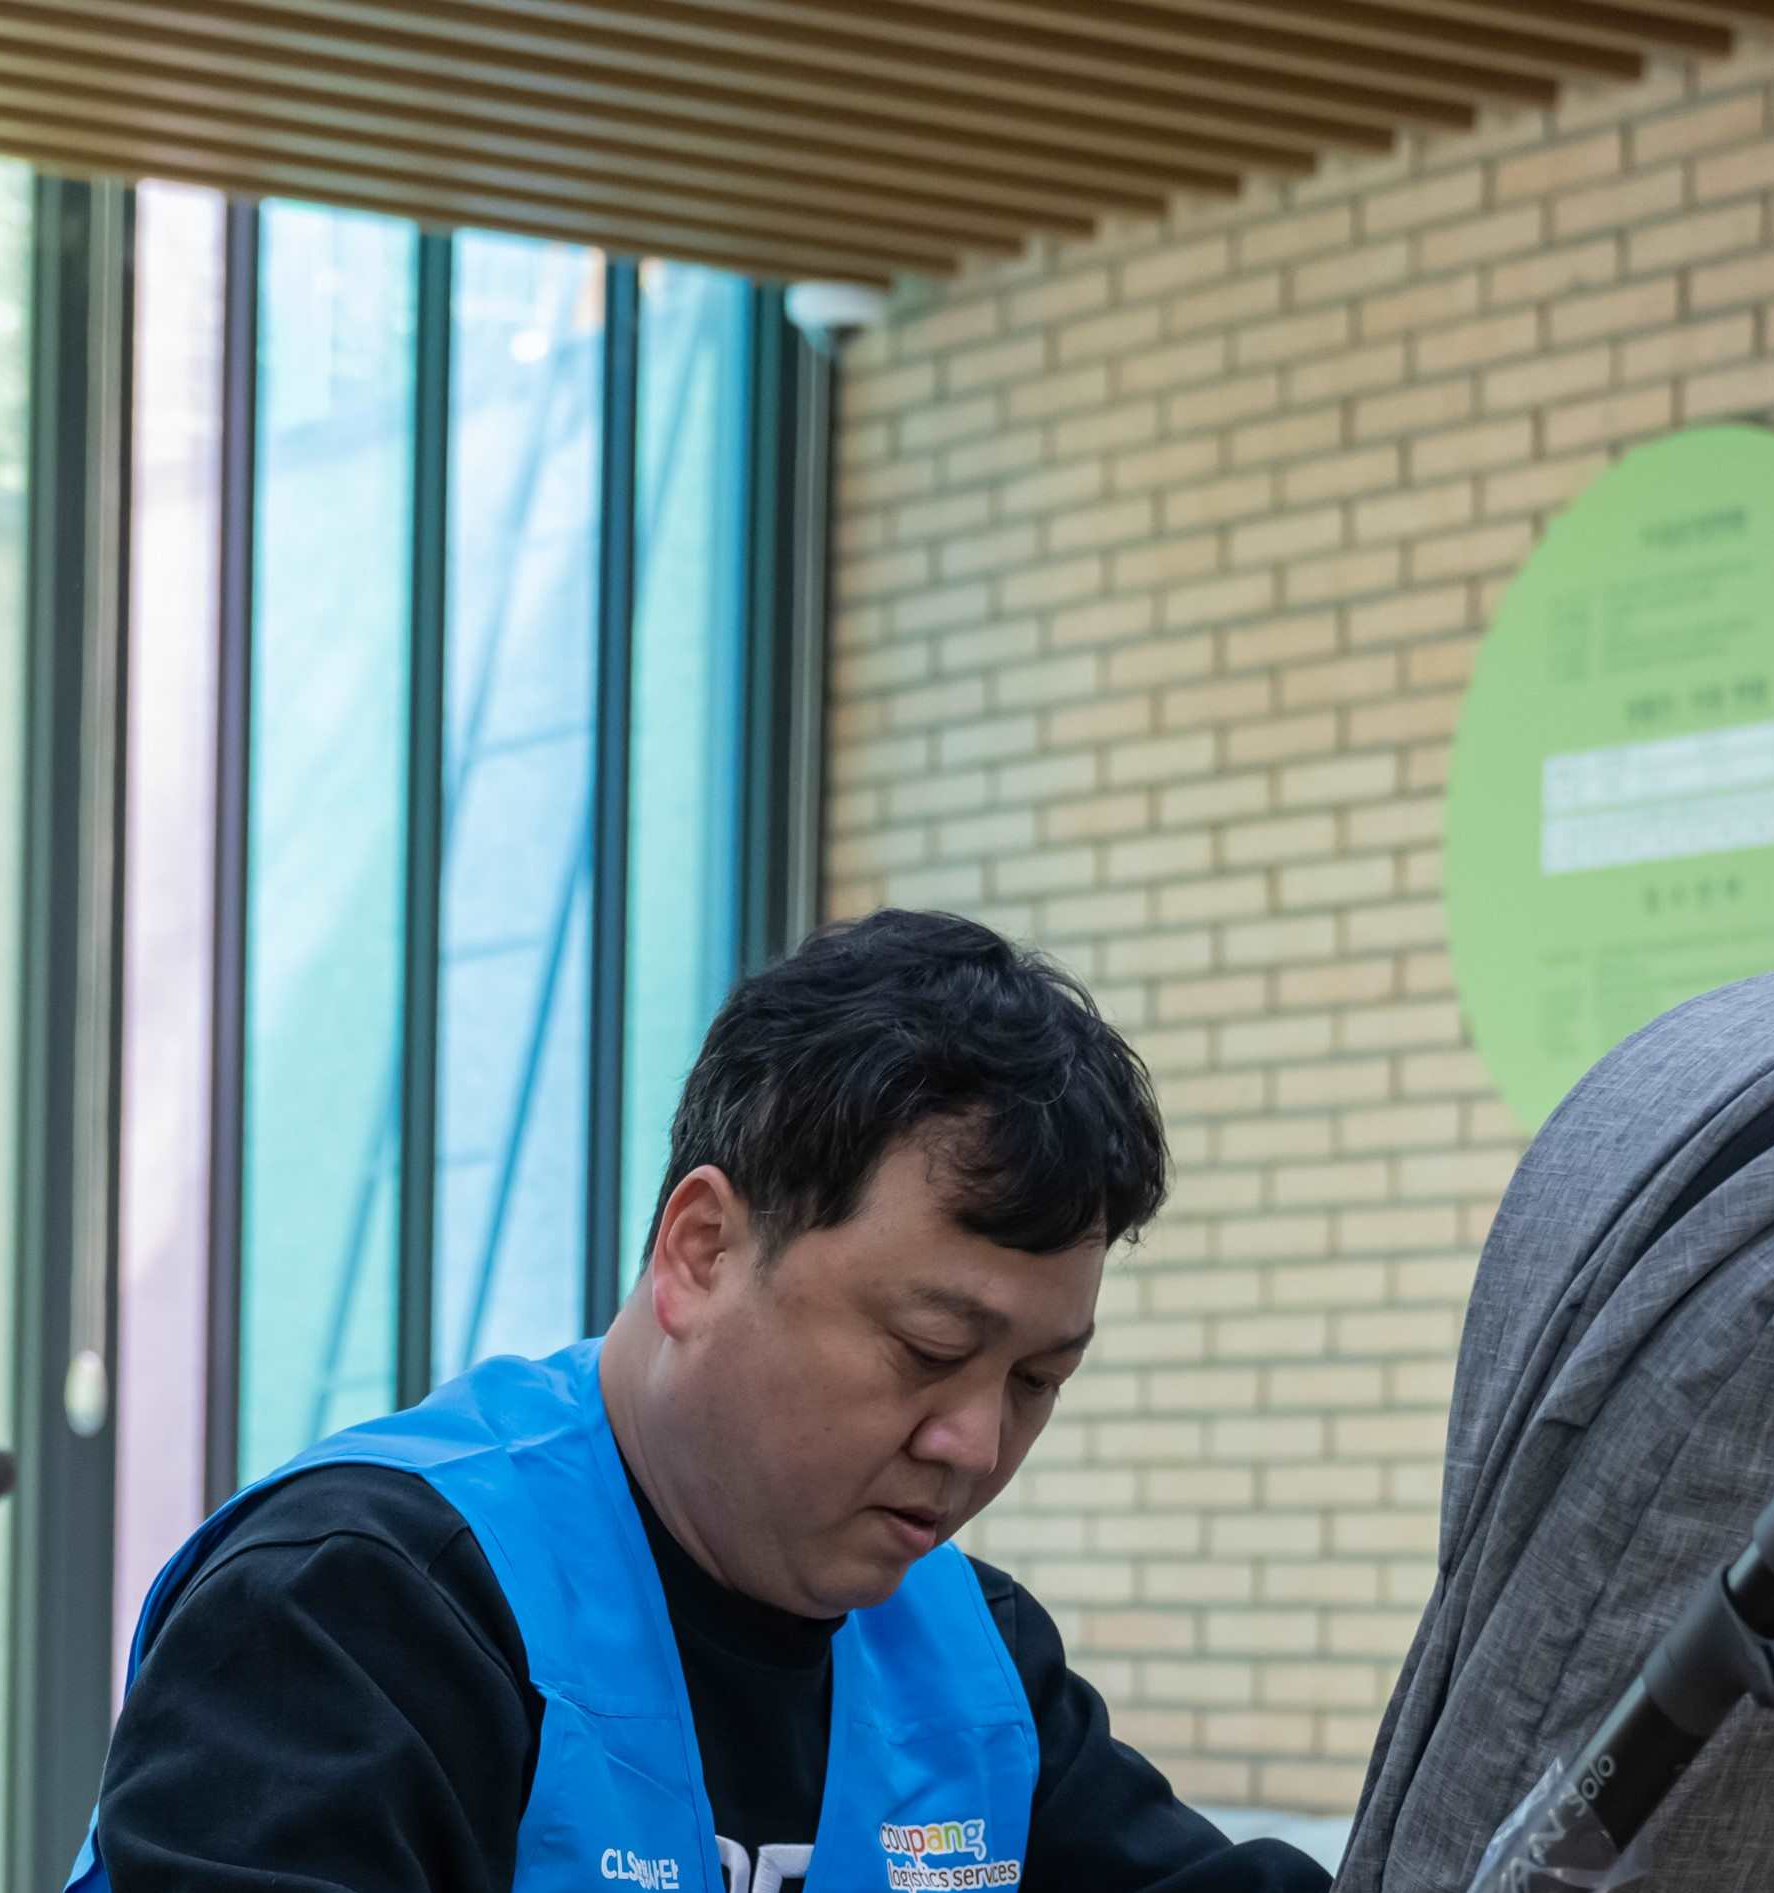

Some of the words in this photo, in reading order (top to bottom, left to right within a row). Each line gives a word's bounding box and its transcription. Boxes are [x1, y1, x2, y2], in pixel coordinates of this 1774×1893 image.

[881, 1821, 985, 1862] coupang
[888, 1859, 949, 1893] logistics
[953, 1862, 1018, 1887] services
